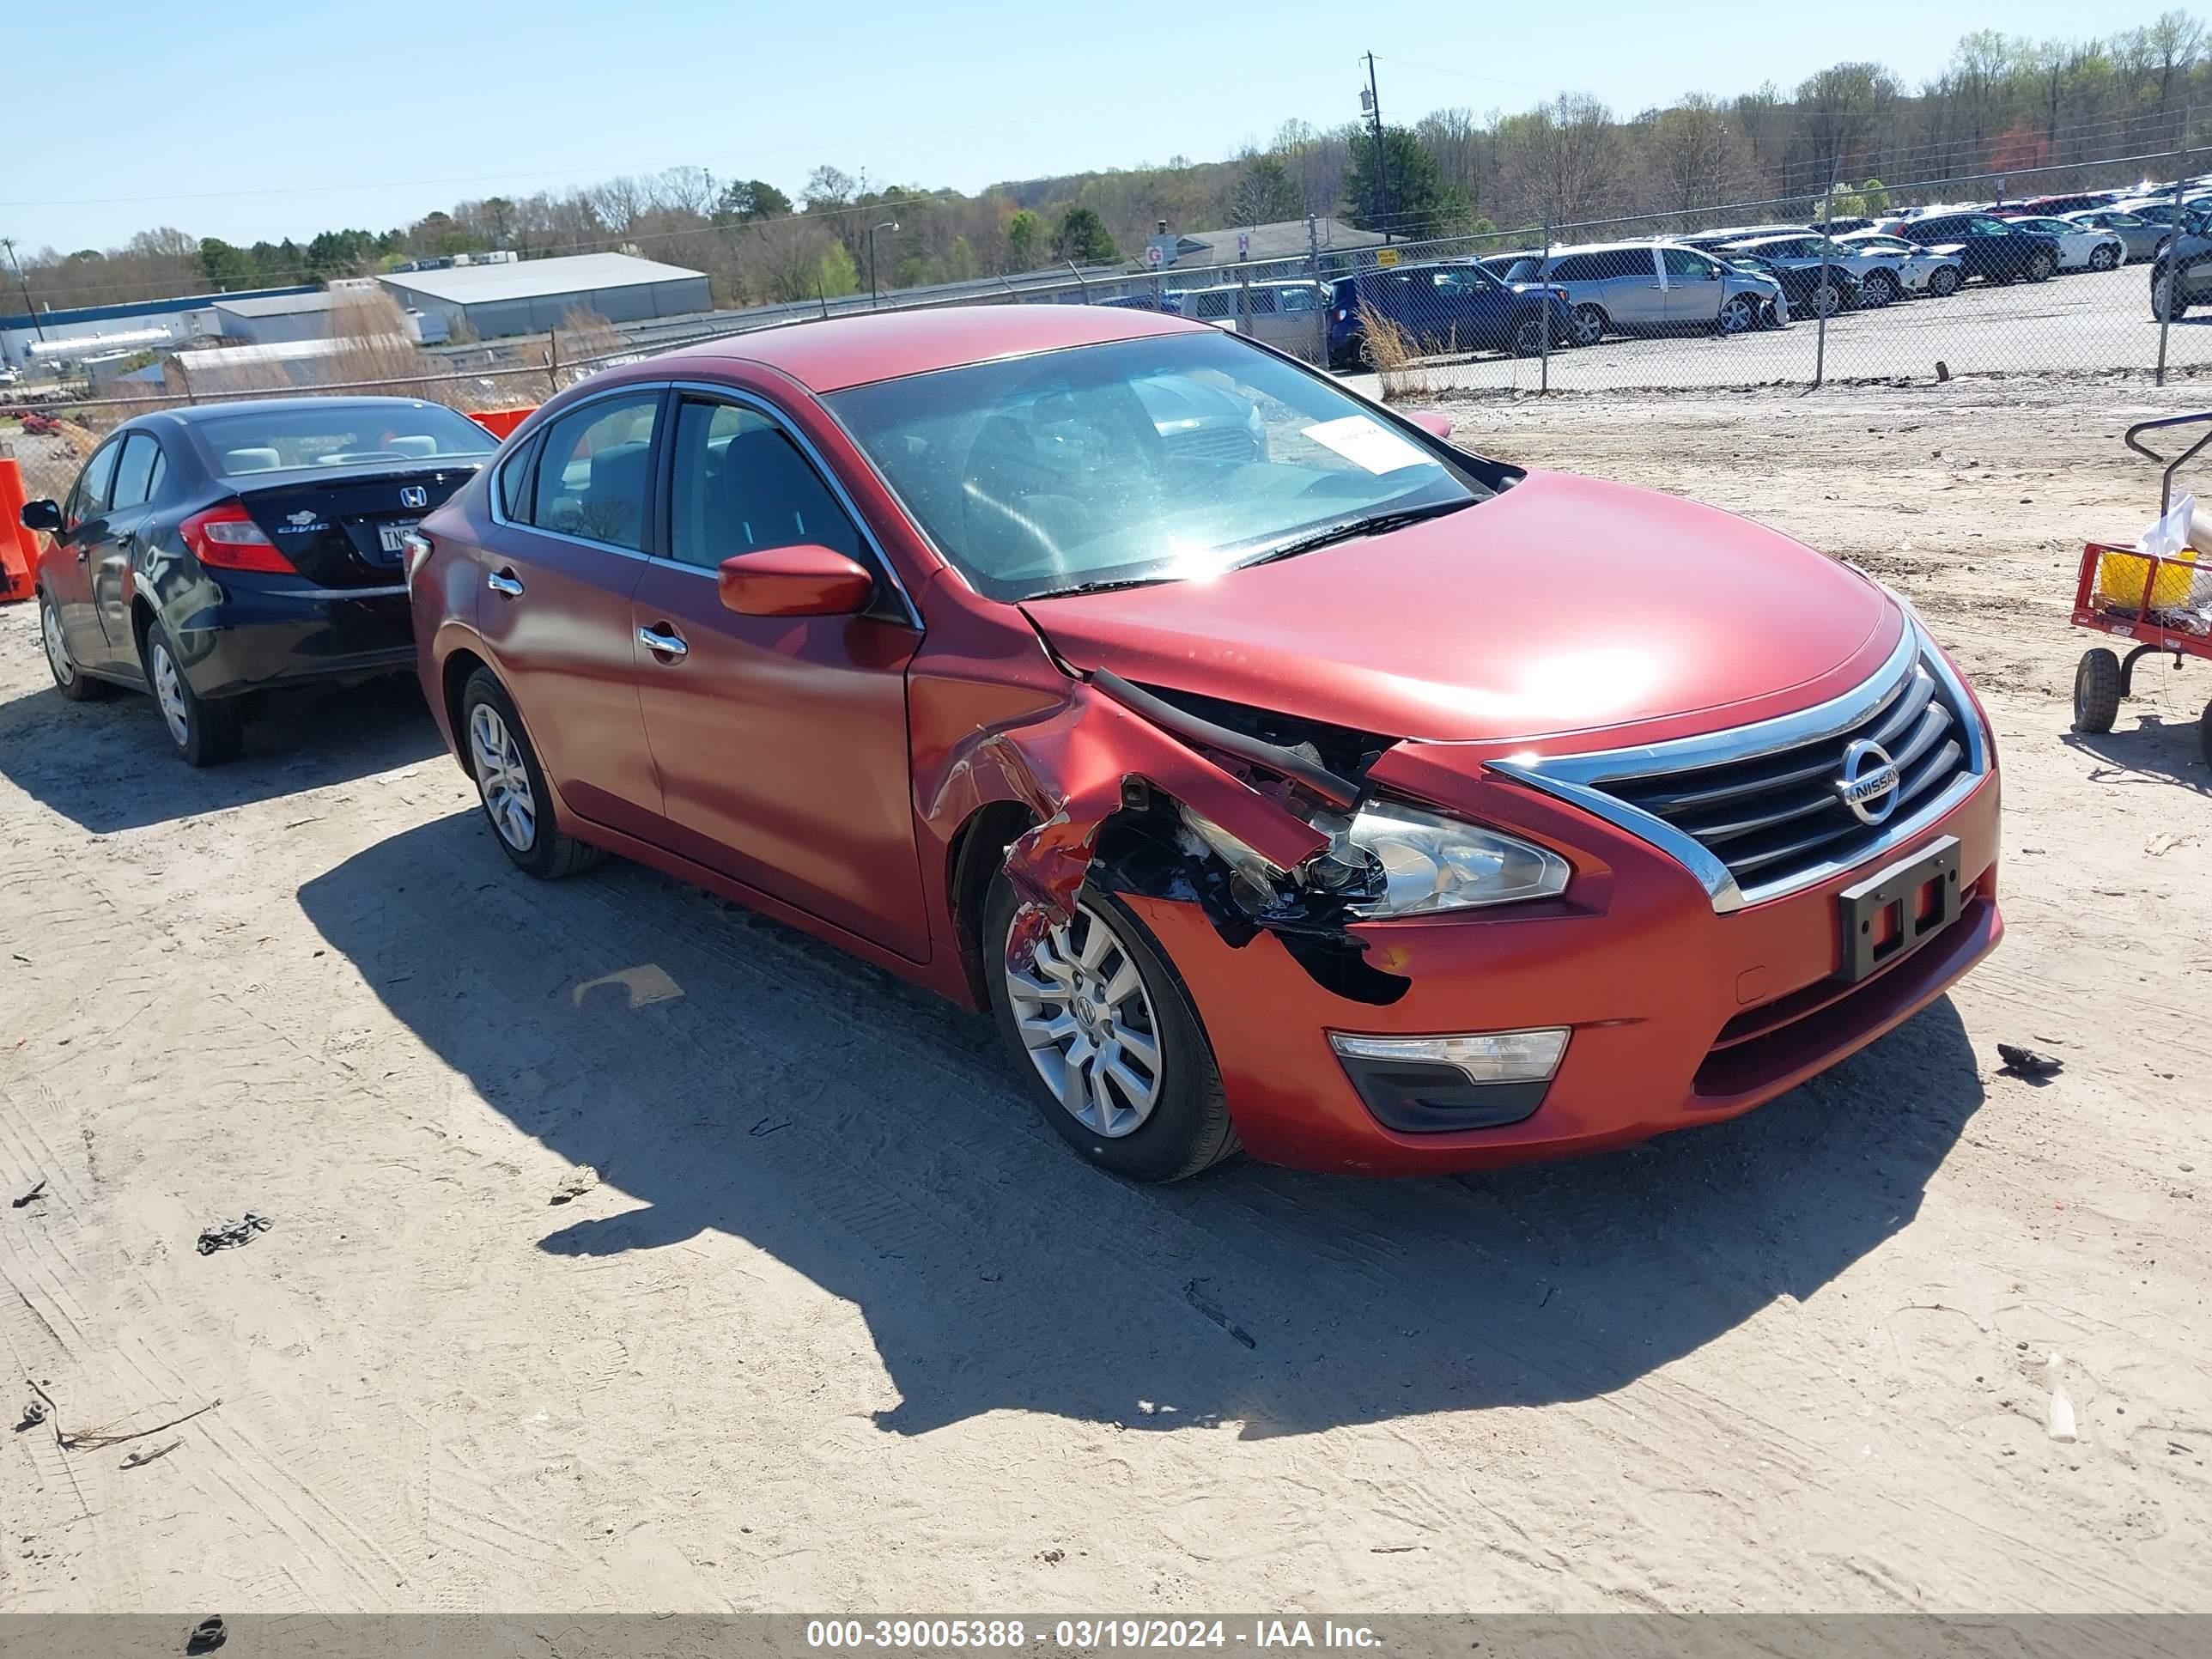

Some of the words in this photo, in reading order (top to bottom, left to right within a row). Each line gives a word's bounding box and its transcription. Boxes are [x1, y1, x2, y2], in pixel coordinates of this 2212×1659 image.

[1148, 248, 1162, 262] G
[277, 522, 331, 534] CIVIC
[1855, 769, 1899, 799] NISSAN
